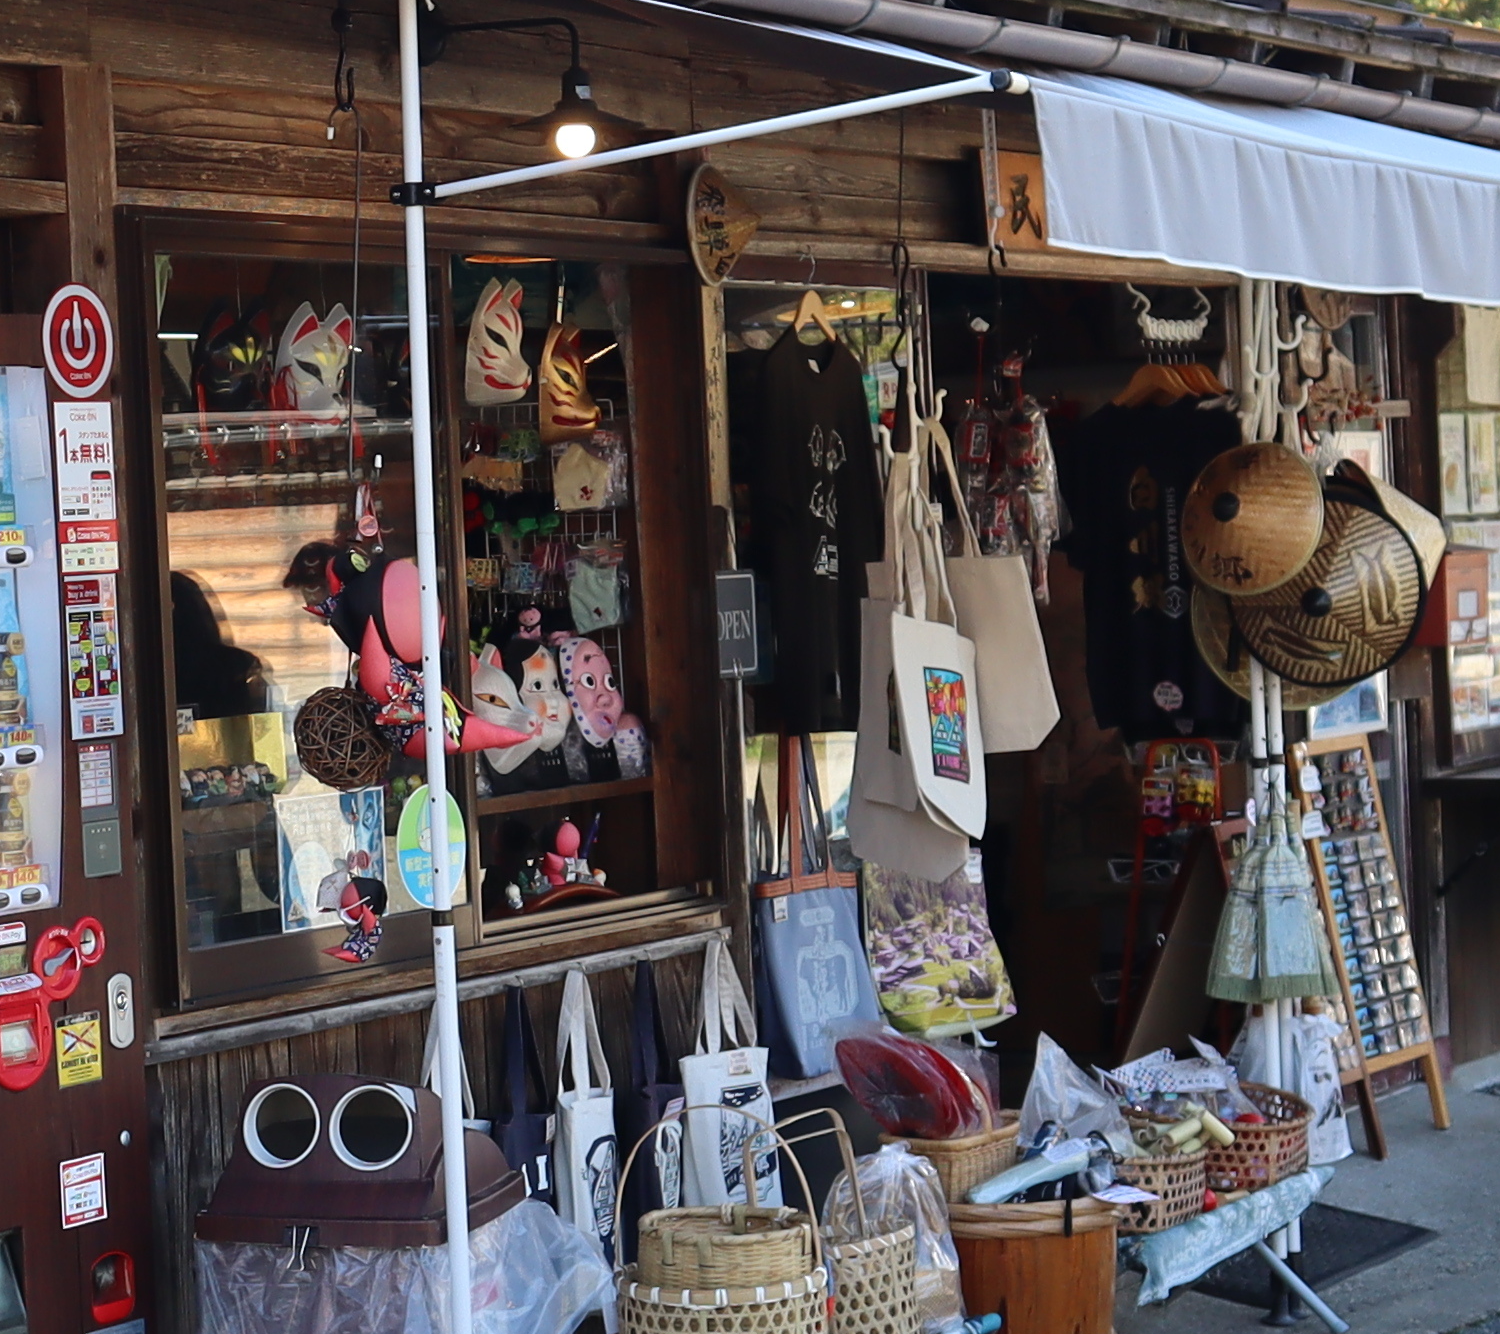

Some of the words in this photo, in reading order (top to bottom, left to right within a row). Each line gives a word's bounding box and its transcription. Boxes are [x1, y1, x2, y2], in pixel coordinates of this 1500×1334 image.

[1165, 486, 1180, 582] SHIRAKAWAGO
[67, 590, 79, 599] buy
[85, 588, 99, 598] drink
